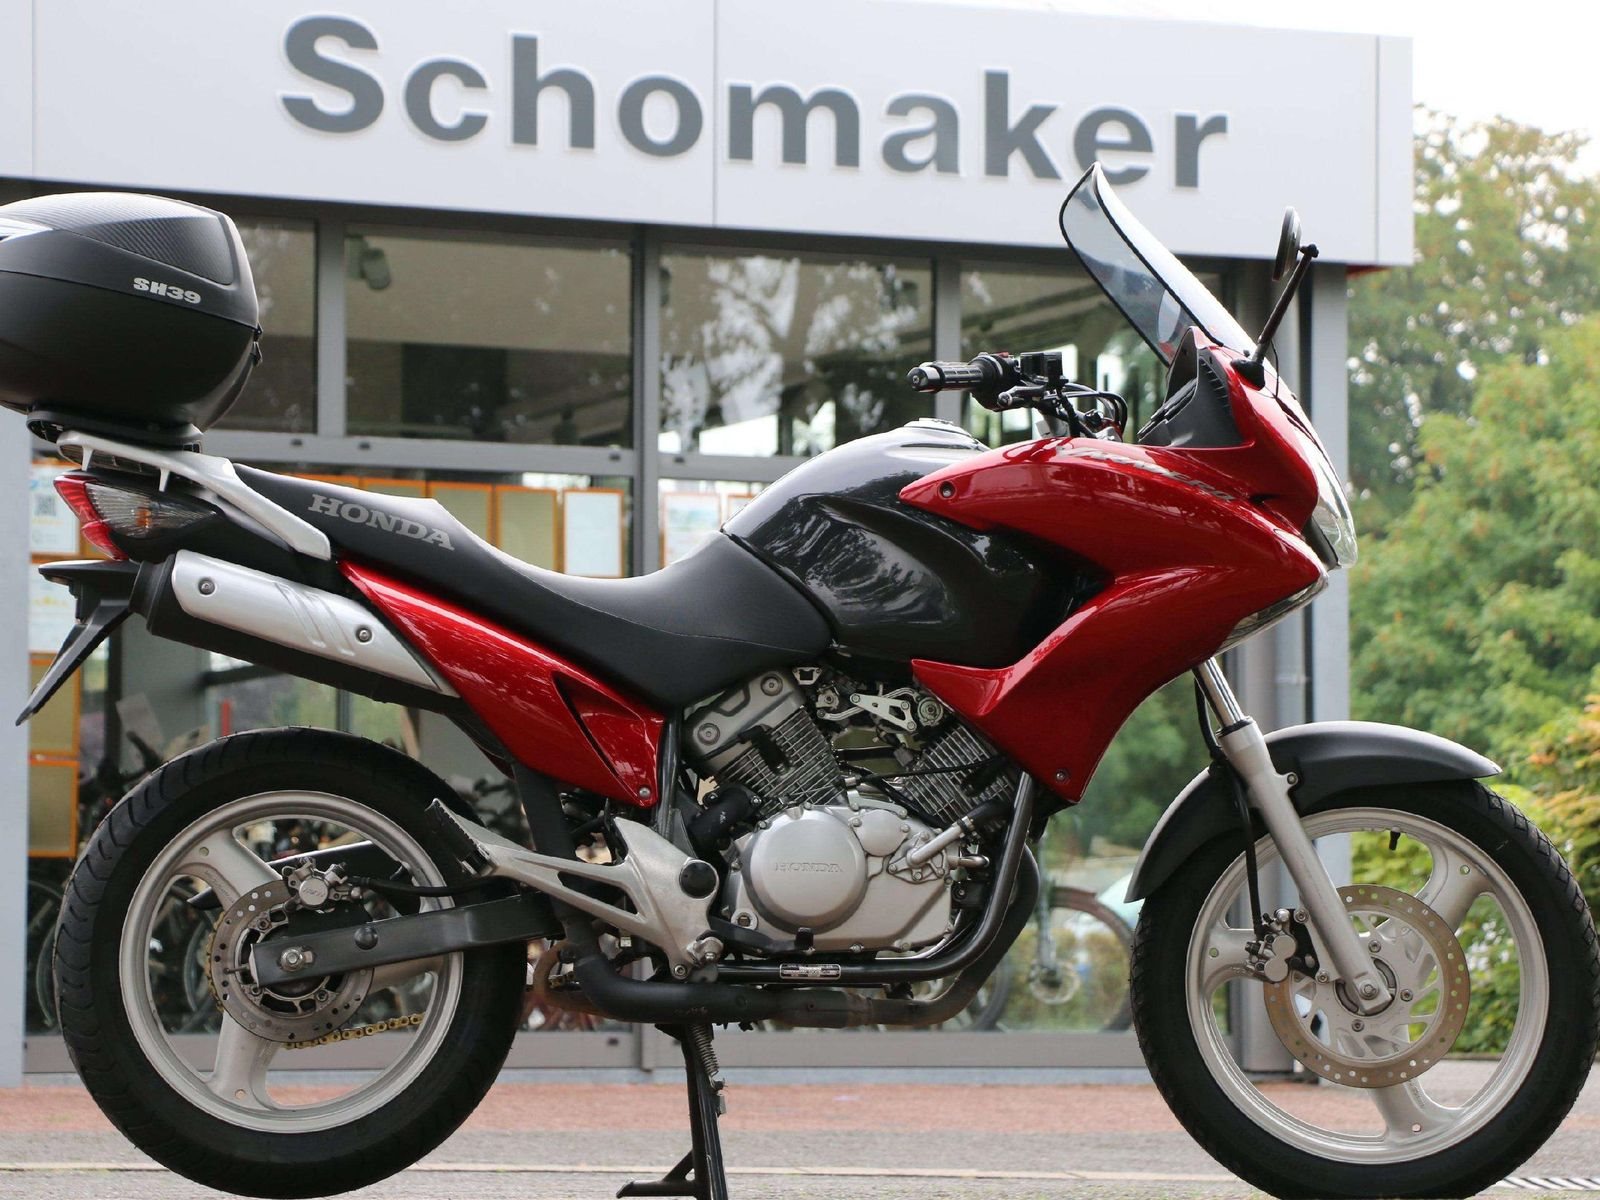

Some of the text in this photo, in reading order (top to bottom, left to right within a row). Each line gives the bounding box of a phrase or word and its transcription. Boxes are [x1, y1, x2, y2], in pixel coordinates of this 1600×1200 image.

[281, 14, 1228, 189] Schomaker
[133, 277, 202, 304] SH39
[307, 494, 456, 551] HONDA
